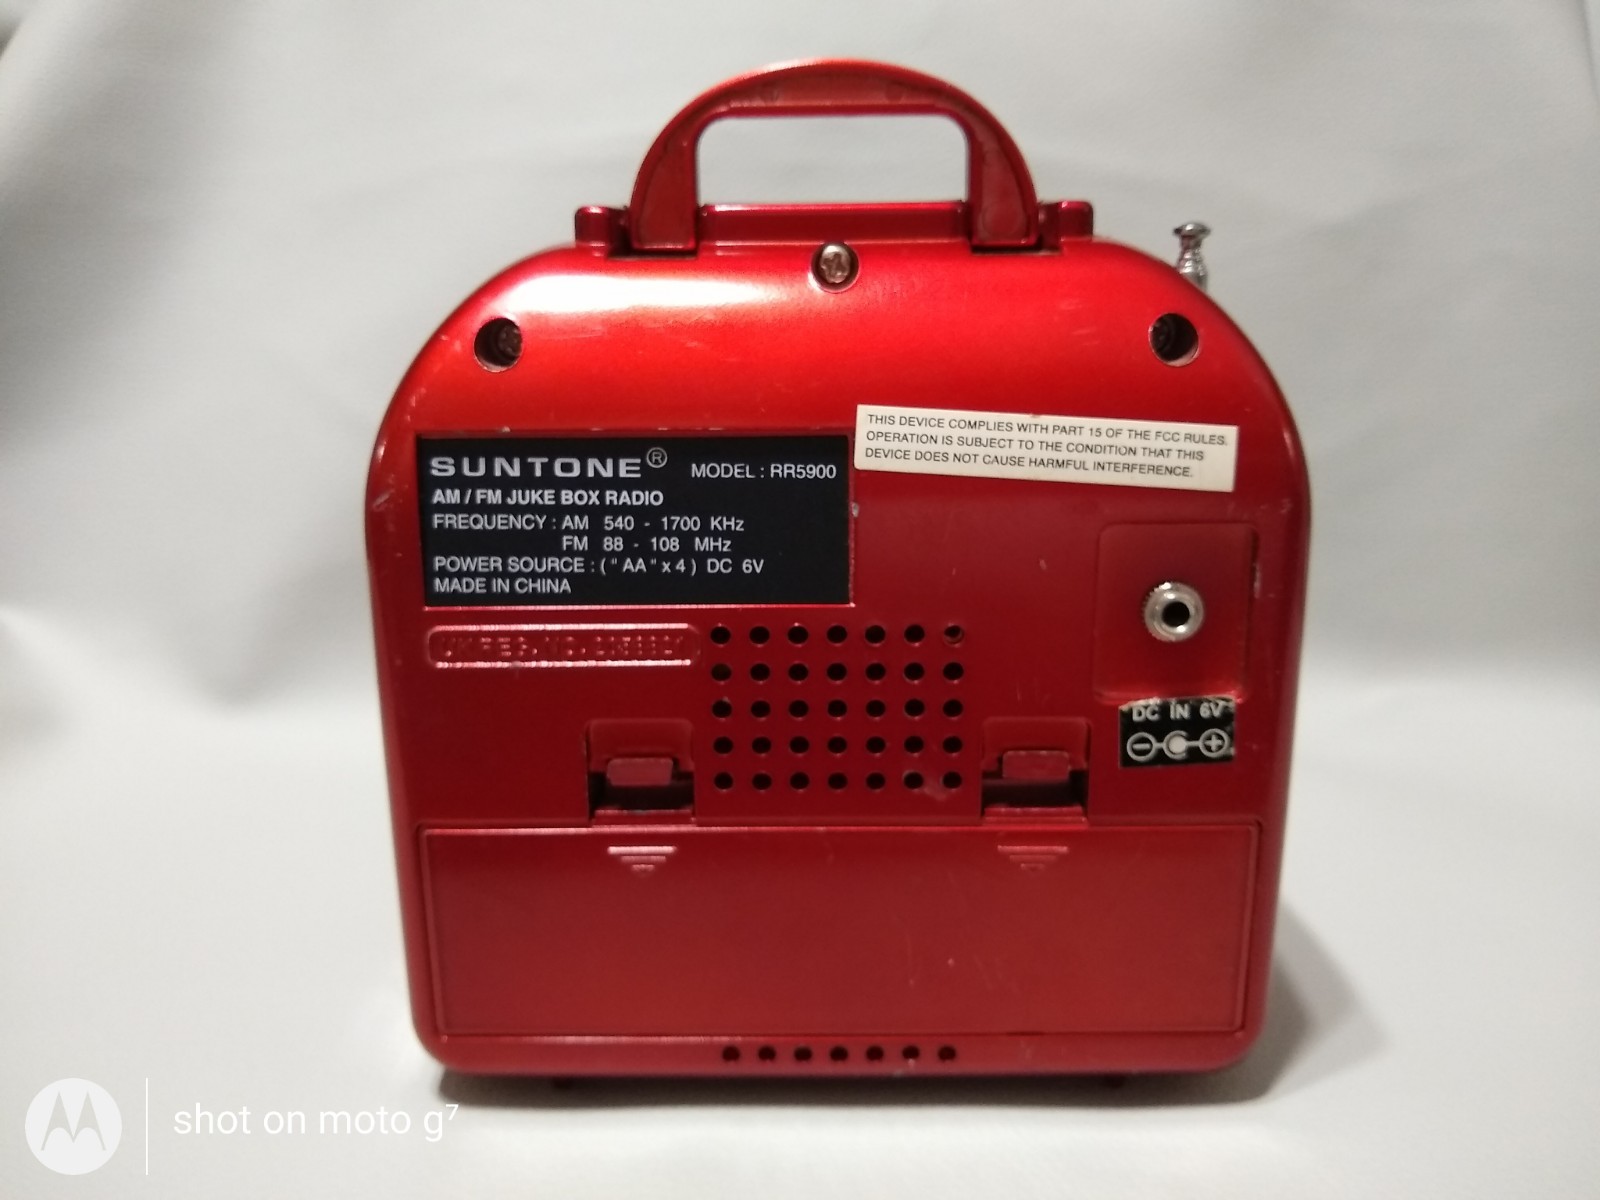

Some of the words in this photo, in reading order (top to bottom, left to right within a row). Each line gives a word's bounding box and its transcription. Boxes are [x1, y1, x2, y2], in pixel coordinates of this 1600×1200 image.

[868, 414, 895, 425] THIS
[899, 416, 944, 428] DEVICE
[949, 419, 1013, 432] COMPLIES
[1017, 423, 1048, 433] WITH
[1053, 425, 1084, 435] PART
[1090, 428, 1102, 437] 15
[1106, 428, 1123, 438] OF
[1128, 429, 1150, 440] THE
[1155, 431, 1180, 442] FCC
[1184, 433, 1227, 445] RULES.
[867, 431, 937, 444] OPERATION
[942, 436, 953, 445] IS
[957, 436, 1014, 448] SUBJECT
[1018, 440, 1034, 450] TO
[1039, 441, 1062, 452] THE
[1066, 443, 1136, 456] CONDITION
[1142, 447, 1172, 458] THAT
[1176, 449, 1204, 461] THIS
[431, 457, 641, 477] SUNTONE
[692, 463, 755, 478] MODEL
[771, 464, 836, 479] RR5900
[866, 448, 910, 460] DEVICE
[915, 451, 949, 462] DOES
[953, 453, 979, 463] NOT
[983, 455, 1024, 466] CAUSE
[1029, 458, 1088, 470] HARMFUL
[1093, 462, 1192, 477] INTERFERENCE.
[432, 489, 460, 504] AM
[476, 489, 501, 504] FM
[506, 490, 555, 505] JUKE
[561, 490, 600, 505] BOX
[606, 490, 663, 505] RADIO
[433, 514, 546, 530] FREQUENCY
[562, 515, 588, 530] AM
[604, 516, 634, 530] 540
[662, 516, 700, 531] 1700
[711, 516, 744, 531] KHz
[563, 536, 588, 550] FM
[603, 537, 623, 551] 88
[651, 537, 679, 552] 108
[695, 537, 731, 551] MHz
[434, 556, 502, 572] POWER
[508, 557, 584, 572] SOURCE
[623, 558, 646, 572] AA
[707, 558, 732, 573] DC
[743, 559, 764, 573] 6V
[434, 578, 486, 593] MADE
[492, 578, 509, 593] IN
[515, 578, 571, 593] CHINA
[1132, 705, 1160, 721] DC
[1169, 702, 1190, 720] IN
[1199, 700, 1226, 718] 6V
